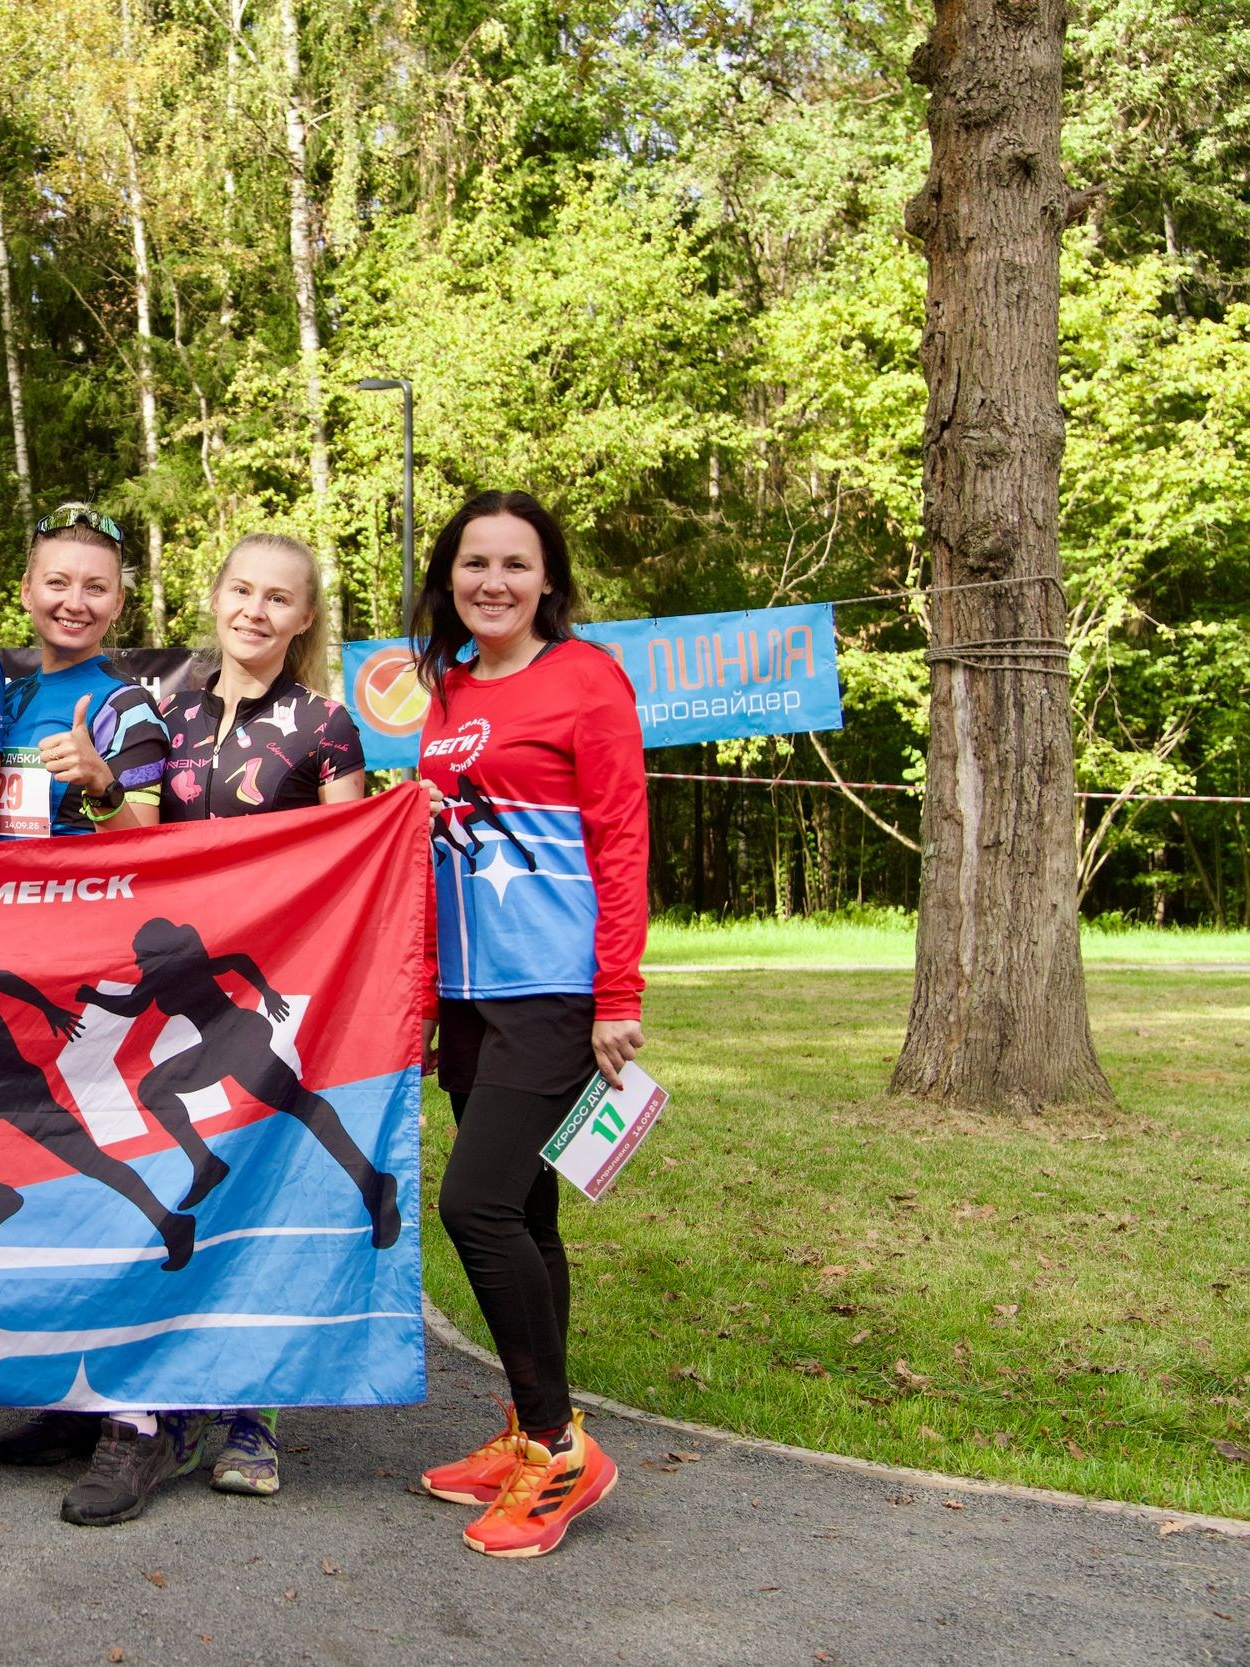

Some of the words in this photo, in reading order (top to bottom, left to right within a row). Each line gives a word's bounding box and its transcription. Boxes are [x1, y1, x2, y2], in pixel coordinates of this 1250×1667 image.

[647, 625, 815, 693] ЛИНИЯ
[5, 753, 41, 765] ДУБКИ
[423, 733, 480, 758] БЕГИ
[4, 821, 40, 831] 14.09.25
[553, 1105, 589, 1150] КРОСС
[586, 1077, 607, 1107] ДУБ
[590, 1101, 626, 1145] 17
[632, 1099, 659, 1138] 14.09.25
